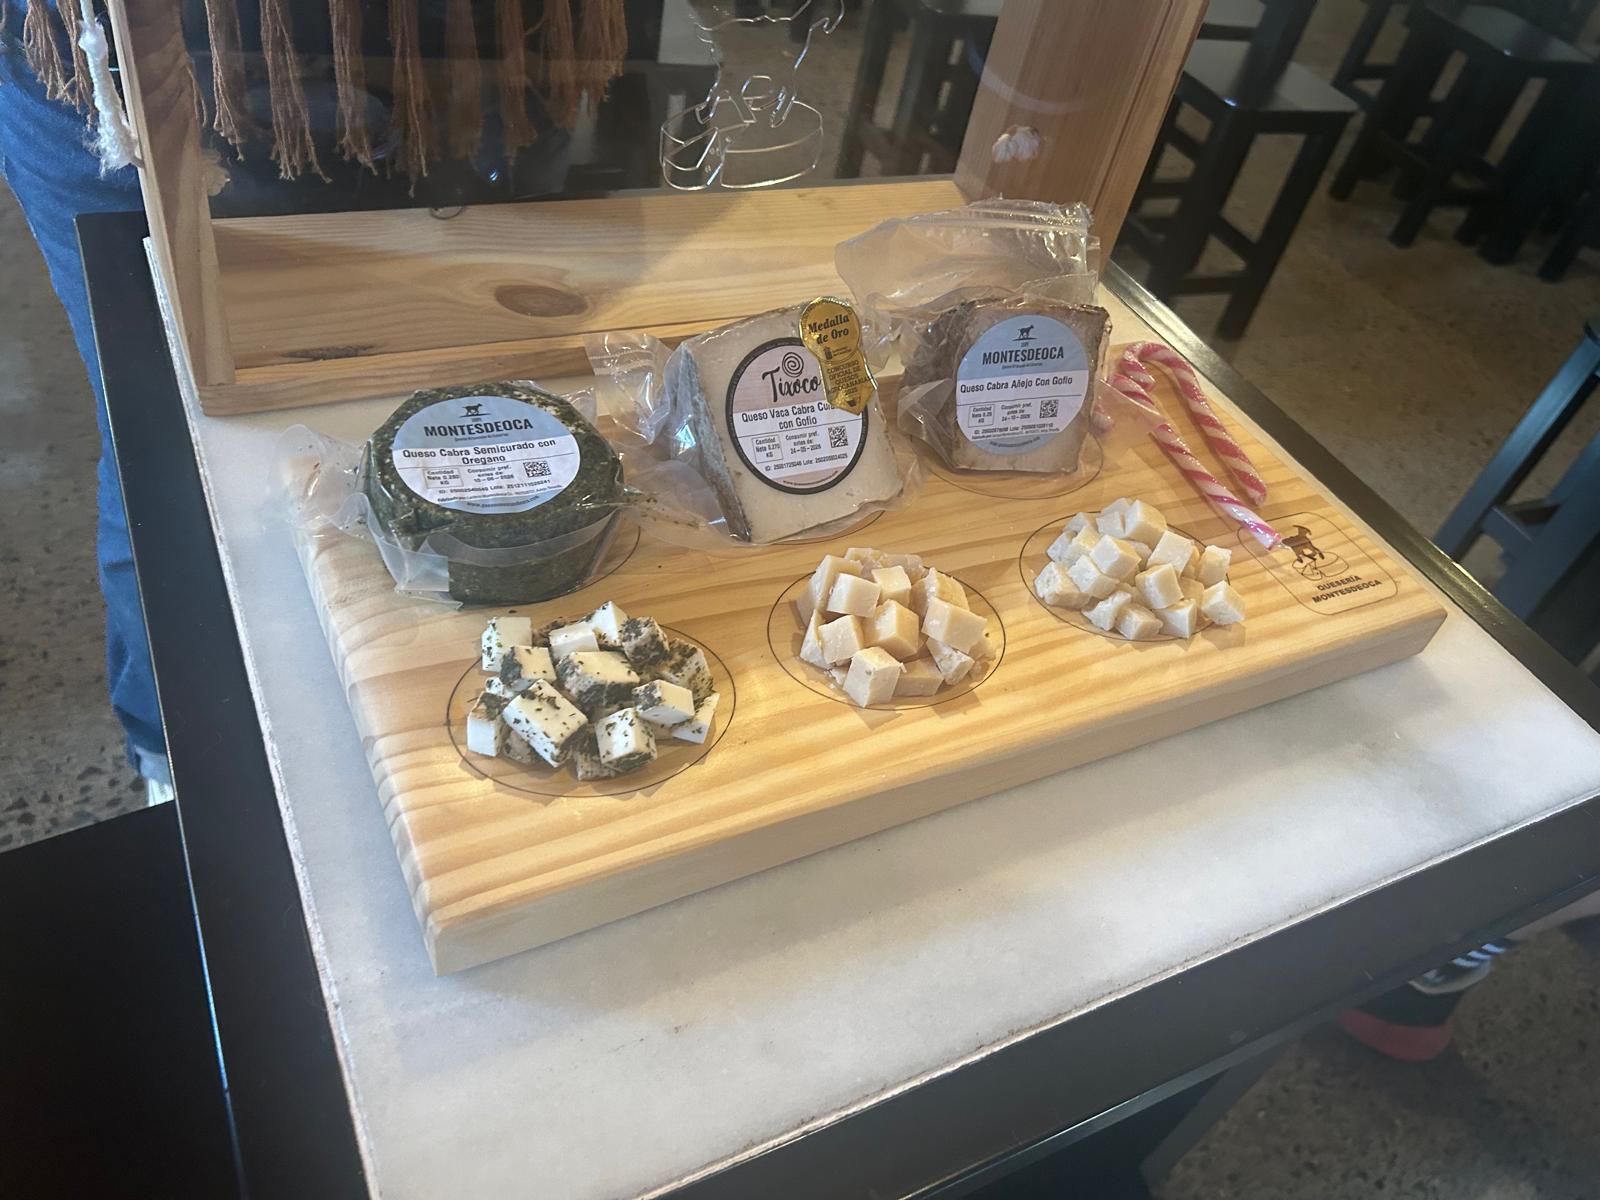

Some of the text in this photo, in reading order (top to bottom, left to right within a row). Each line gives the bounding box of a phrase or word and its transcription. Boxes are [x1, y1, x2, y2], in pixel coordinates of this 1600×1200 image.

[808, 314, 850, 334] Medalla
[816, 328, 849, 345] de Oro
[982, 346, 1064, 365] MONTESDEOCA
[761, 366, 821, 402] Tixoco
[960, 375, 1073, 394] Queso Cabra Añejo Con Gofio
[741, 411, 768, 423] Queso
[769, 408, 790, 419] Vaca
[791, 405, 815, 416] Cabra
[779, 416, 818, 430] con Gofio
[423, 418, 534, 437] MONTESDEOCA
[402, 438, 556, 459] Queso Cabra Semicurado con
[461, 456, 506, 465] Oregano
[1311, 580, 1382, 604] MONTESDEOCA
[1316, 575, 1362, 591] QUESERÍA
